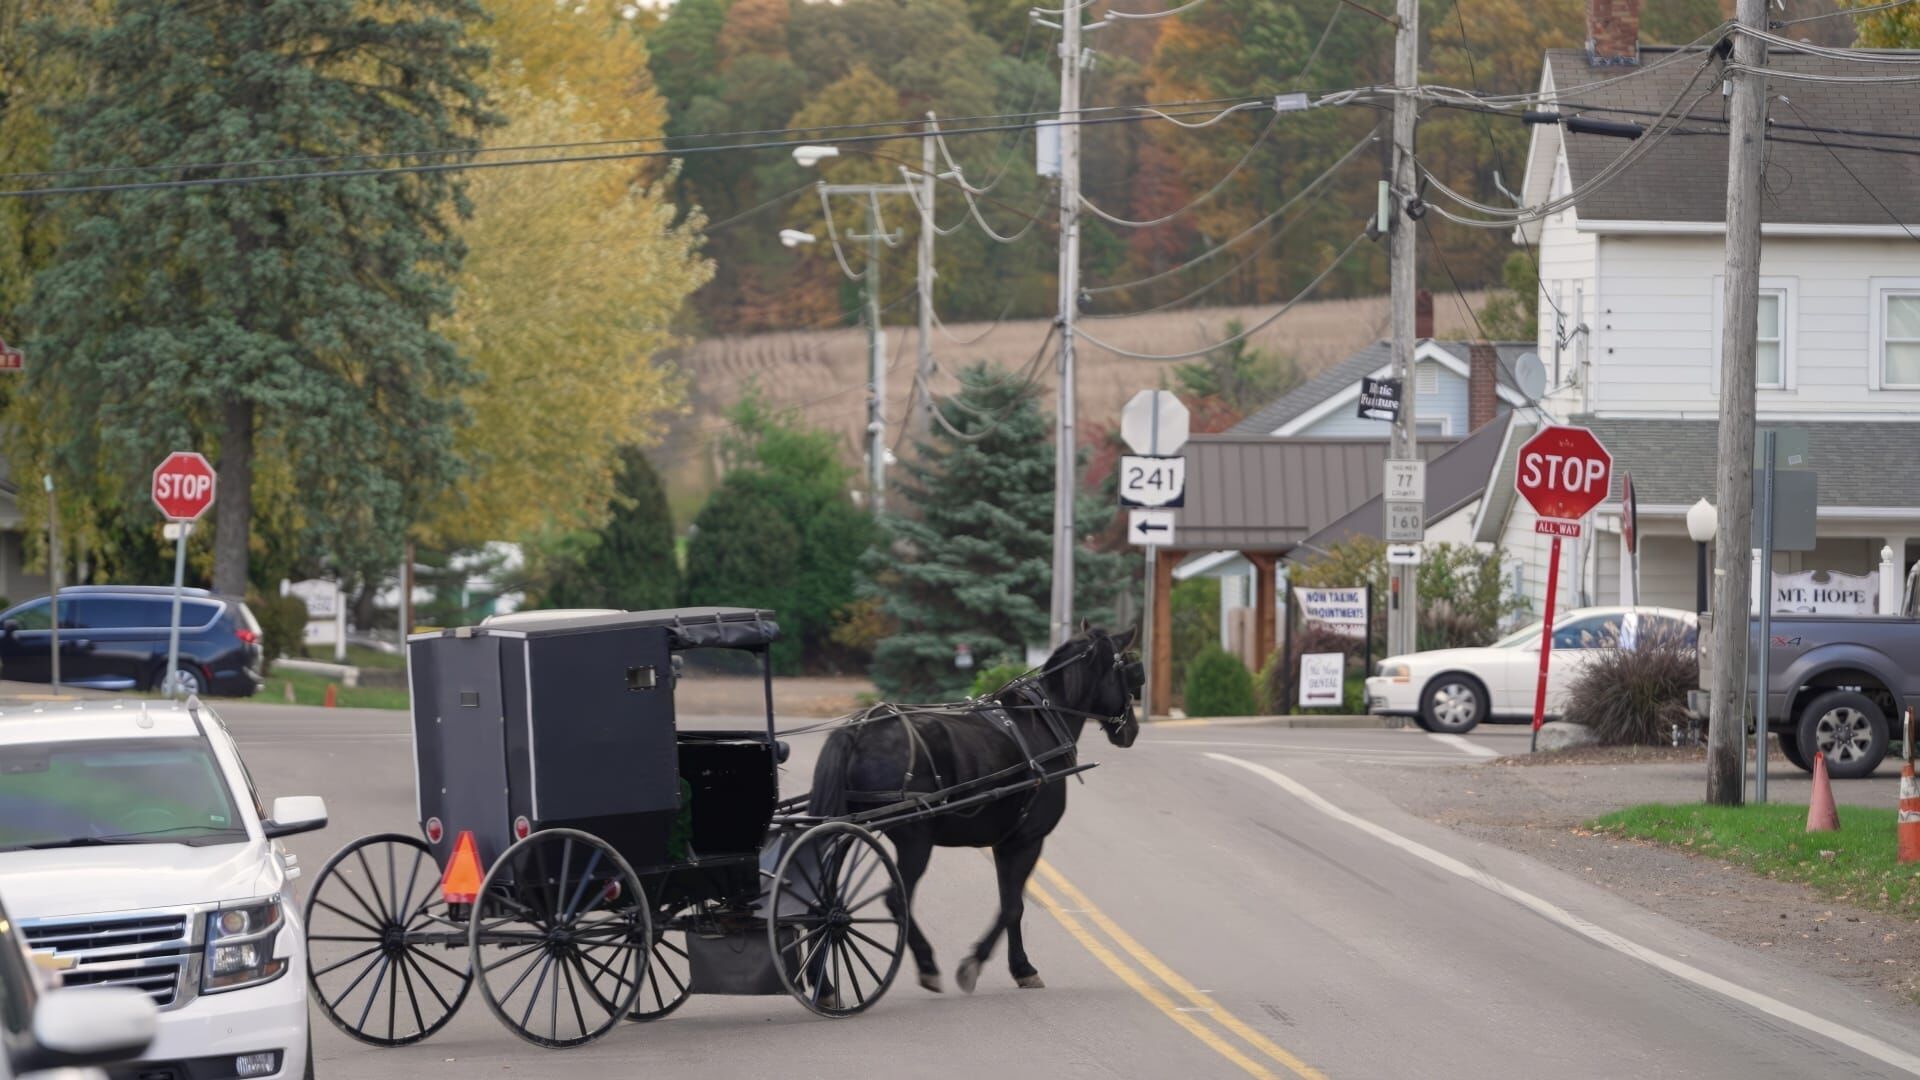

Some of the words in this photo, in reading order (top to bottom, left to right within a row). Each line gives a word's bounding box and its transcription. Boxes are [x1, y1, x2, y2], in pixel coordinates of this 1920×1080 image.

[1128, 466, 1175, 491] 241
[1522, 452, 1606, 494] STOP
[157, 472, 211, 500] STOP
[1396, 474, 1413, 488] 77
[1392, 515, 1419, 529] 160
[1537, 521, 1555, 534] ALL
[1559, 524, 1579, 536] WAY
[1306, 591, 1327, 602] NOW
[1329, 591, 1359, 602] TAKING
[1777, 588, 1807, 602] MT.
[1813, 588, 1866, 603] HOPE
[1770, 636, 1802, 646] X4
